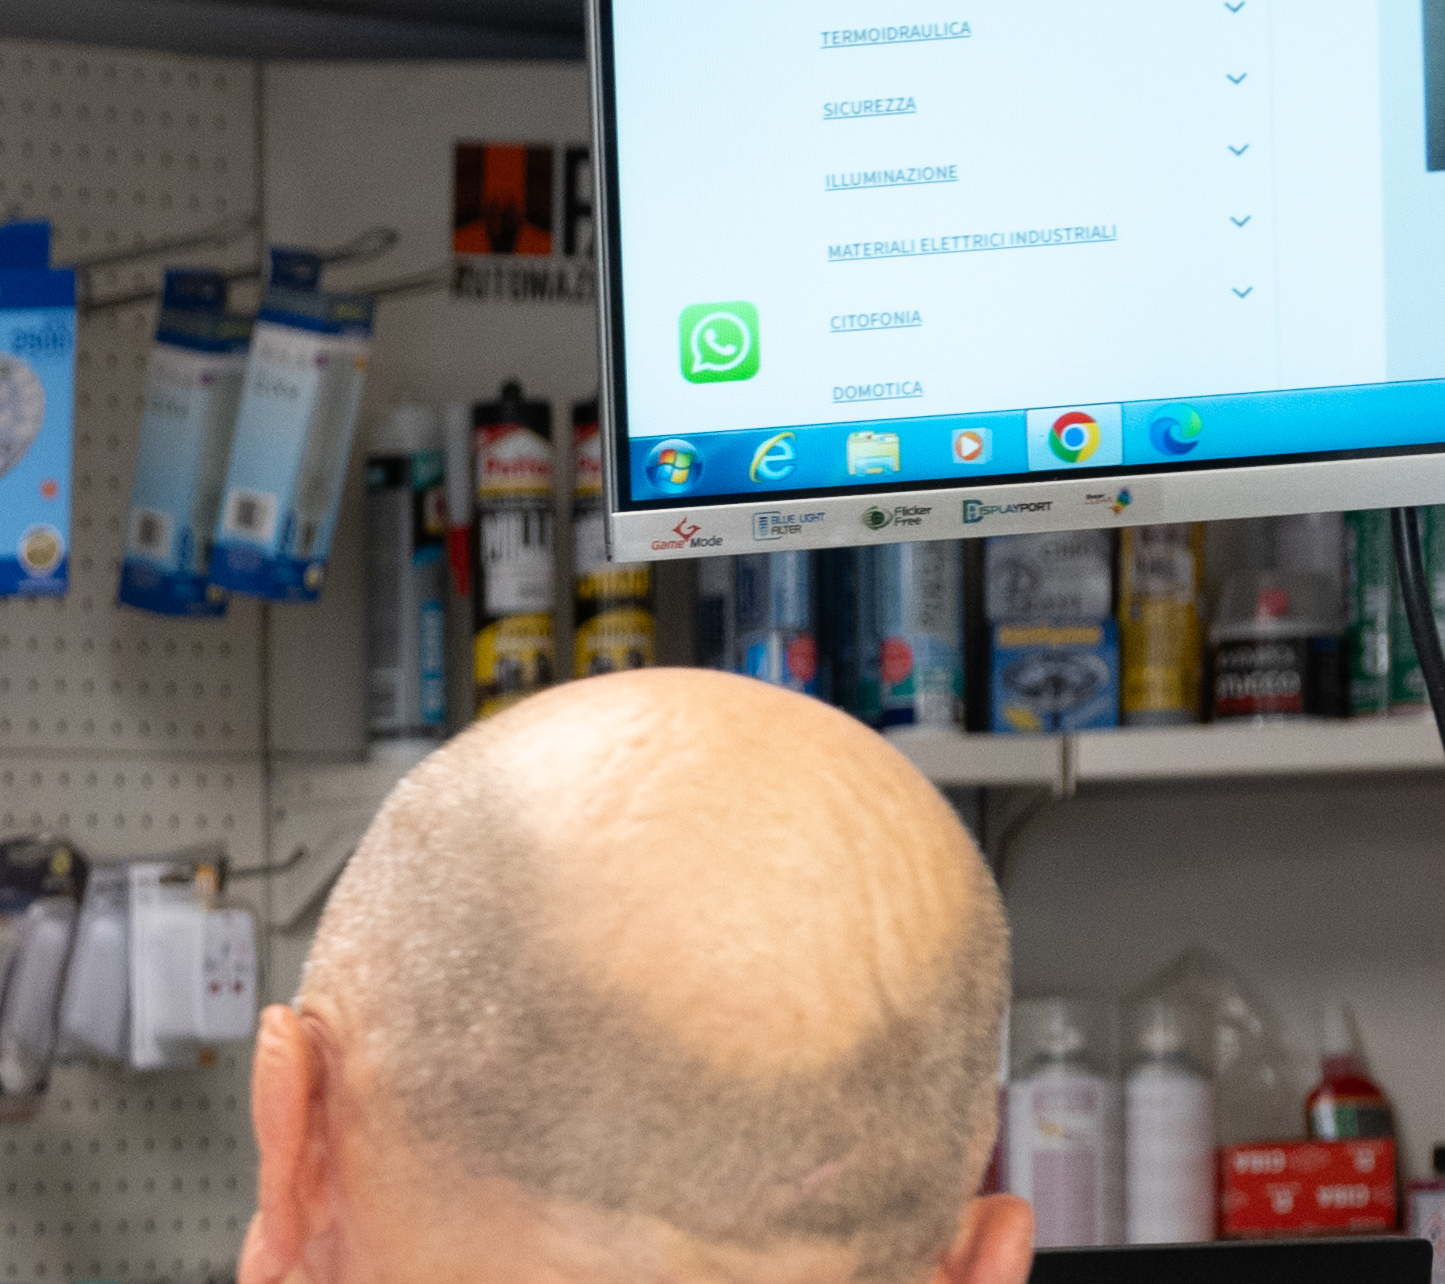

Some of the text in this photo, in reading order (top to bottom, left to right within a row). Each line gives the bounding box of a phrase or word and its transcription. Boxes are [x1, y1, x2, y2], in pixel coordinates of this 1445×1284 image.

[820, 21, 971, 46] TERMOIDRAULICA
[823, 96, 916, 117] SICUREZZA
[826, 165, 958, 189] ILLUMINAZIONE
[828, 224, 1117, 259] MATERIALI ELETTRICI INDUSTRIALI
[830, 309, 922, 330] CITOFONIA
[833, 381, 923, 401] DOMOTICA
[772, 512, 825, 525] BLUE LIGHT
[894, 506, 932, 518] Flicker
[894, 515, 922, 527] Free
[772, 524, 802, 535] FILTER
[651, 535, 723, 551] Game Mode
